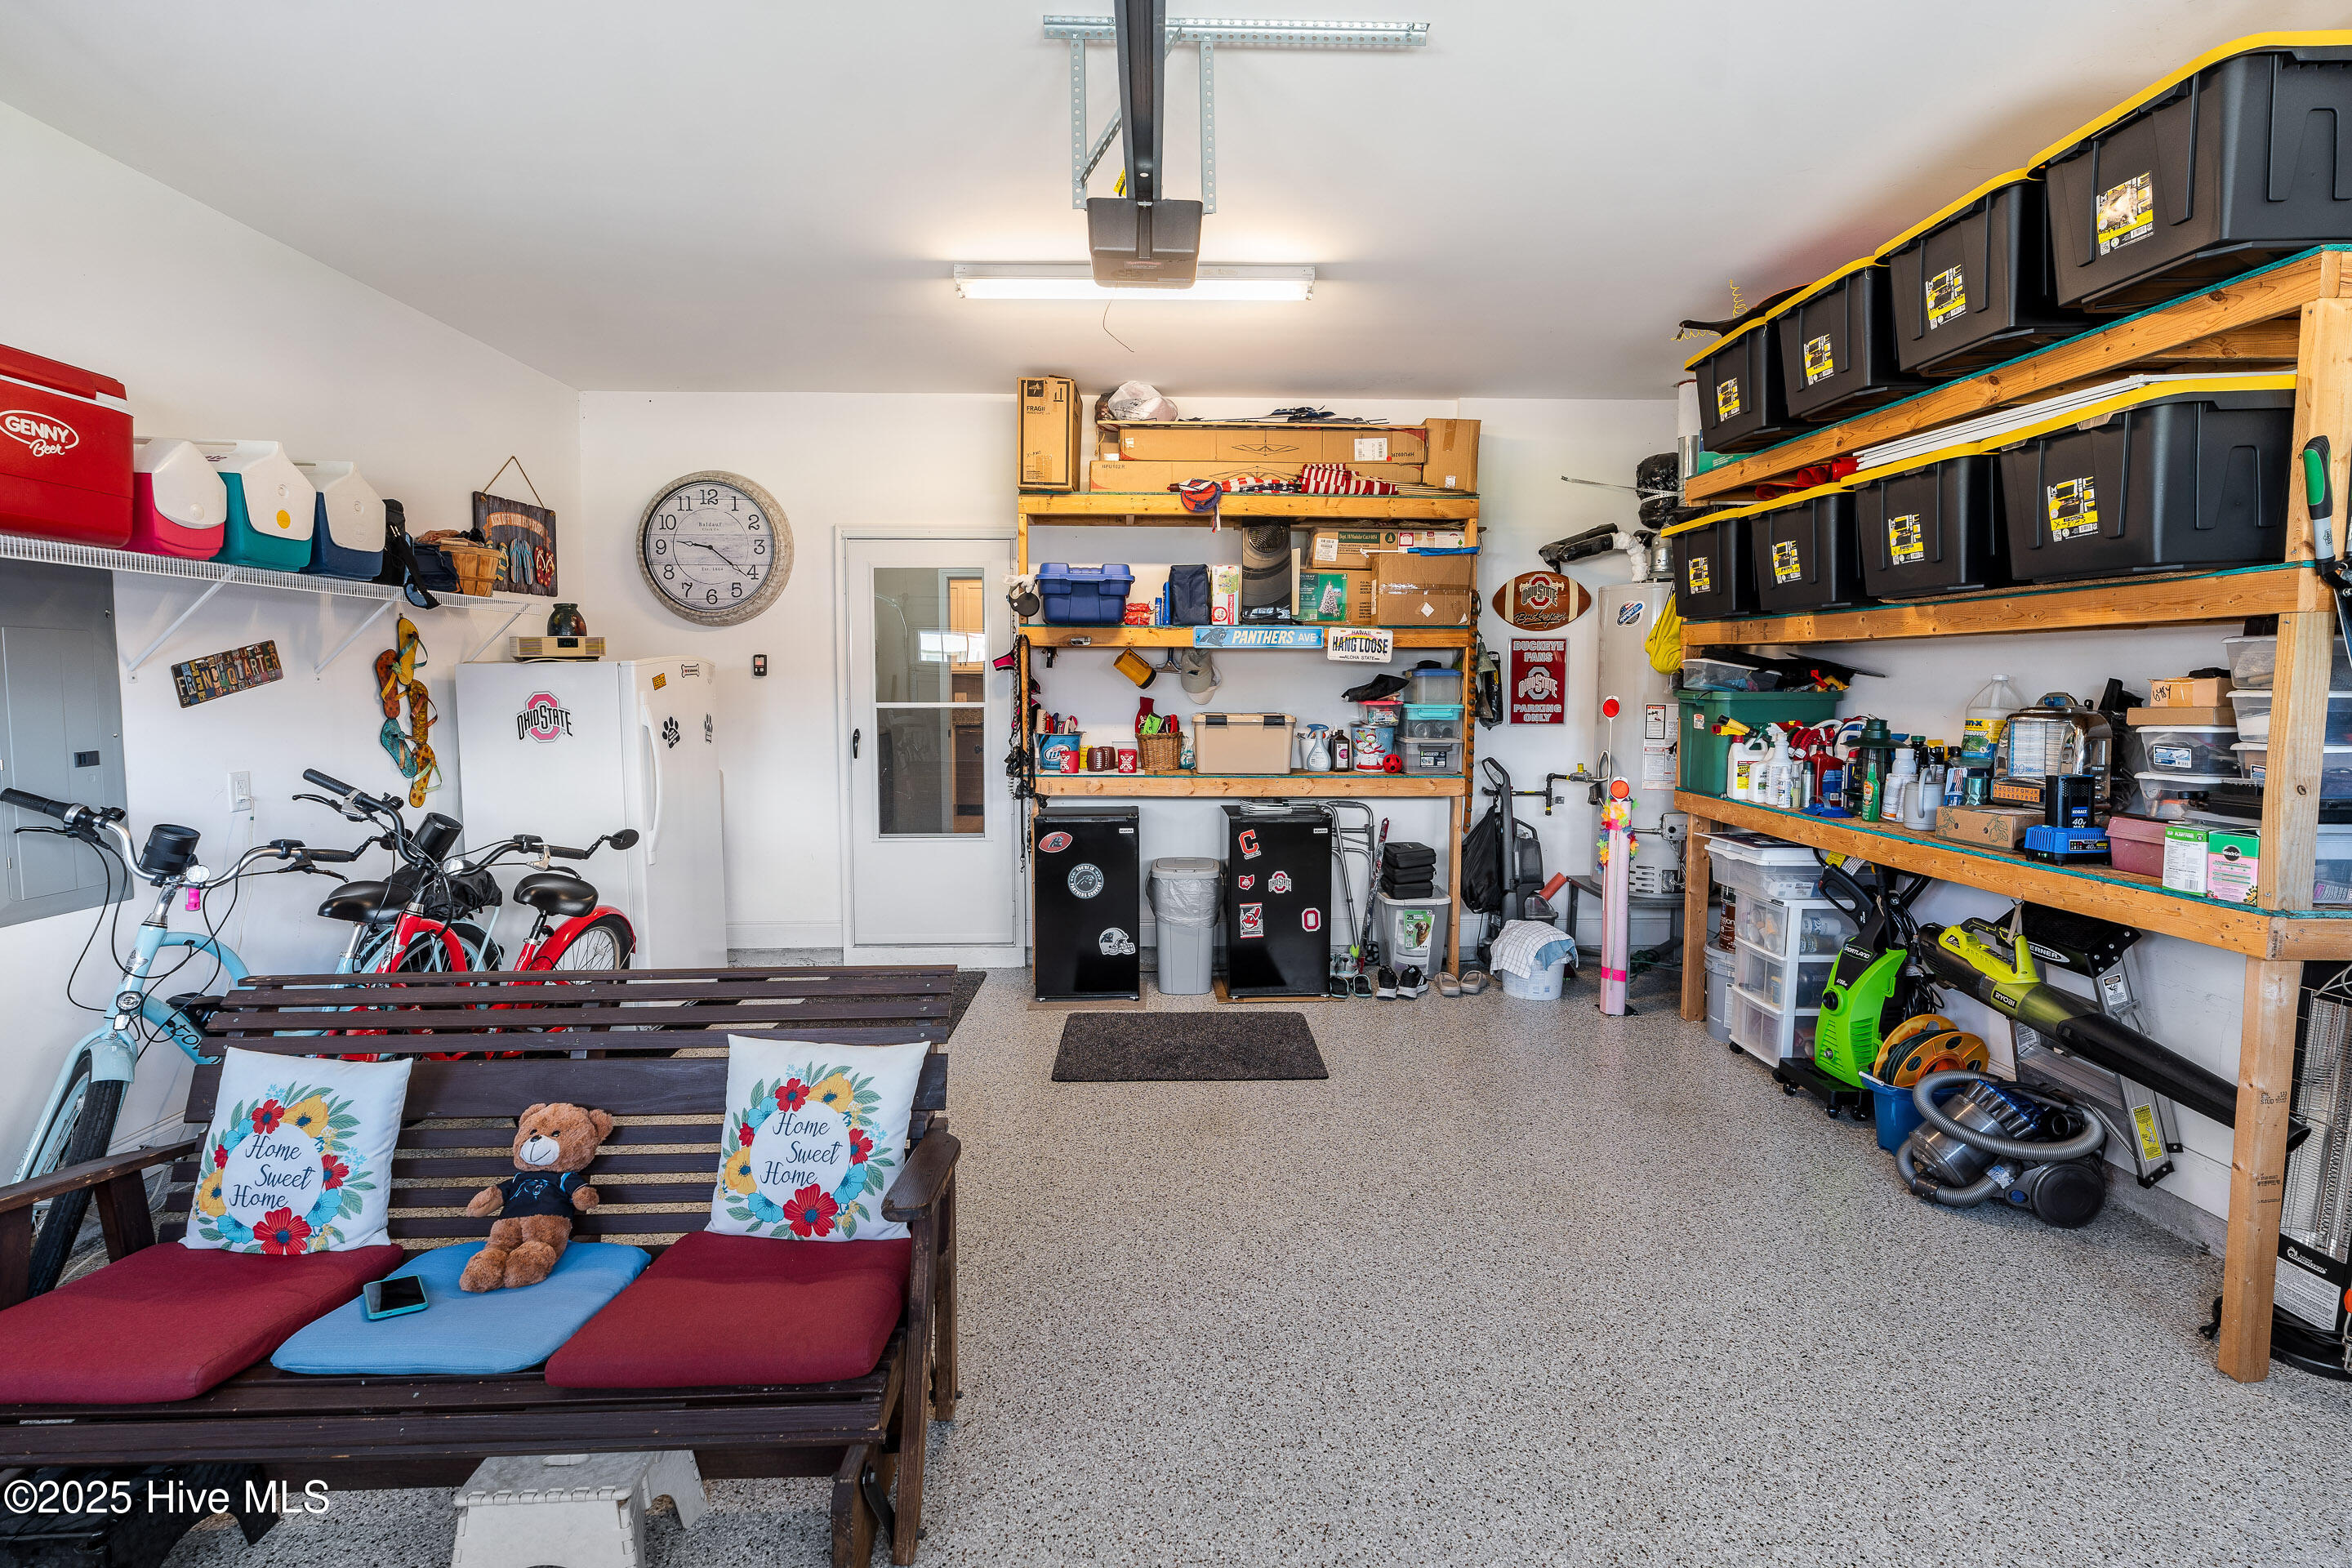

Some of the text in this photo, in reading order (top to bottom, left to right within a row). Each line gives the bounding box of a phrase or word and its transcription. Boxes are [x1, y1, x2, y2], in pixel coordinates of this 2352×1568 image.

[5, 416, 69, 443] GENNY
[29, 439, 65, 457] Beer
[677, 496, 693, 512] 11
[700, 489, 719, 506] 12
[731, 496, 739, 512] 1
[659, 514, 677, 531] 10
[748, 514, 760, 531] 2
[655, 539, 667, 555] 9
[753, 539, 765, 555] 3
[663, 564, 675, 581] 8
[746, 564, 759, 581] 4
[681, 581, 693, 599] 7
[706, 588, 718, 605] 6
[730, 581, 742, 598] 5
[1232, 630, 1316, 644] PANTHERS AVE
[1332, 635, 1388, 654] HANG LOOSE
[1512, 640, 1565, 651] BUCKEYE
[1524, 652, 1553, 662] FANS
[176, 653, 281, 696] FRENCH QUARTER
[1512, 703, 1561, 713] PARKING
[1523, 713, 1552, 723] ONLY
[1844, 947, 1870, 959] PORTLAND
[2029, 944, 2058, 959] ERNER
[1994, 991, 2016, 1007] RYOBI
[772, 1111, 831, 1137] Home
[245, 1134, 302, 1160] Home
[786, 1140, 844, 1165] Sweet
[254, 1164, 316, 1190] Sweet
[760, 1160, 818, 1187] Home
[229, 1184, 289, 1209] Home
